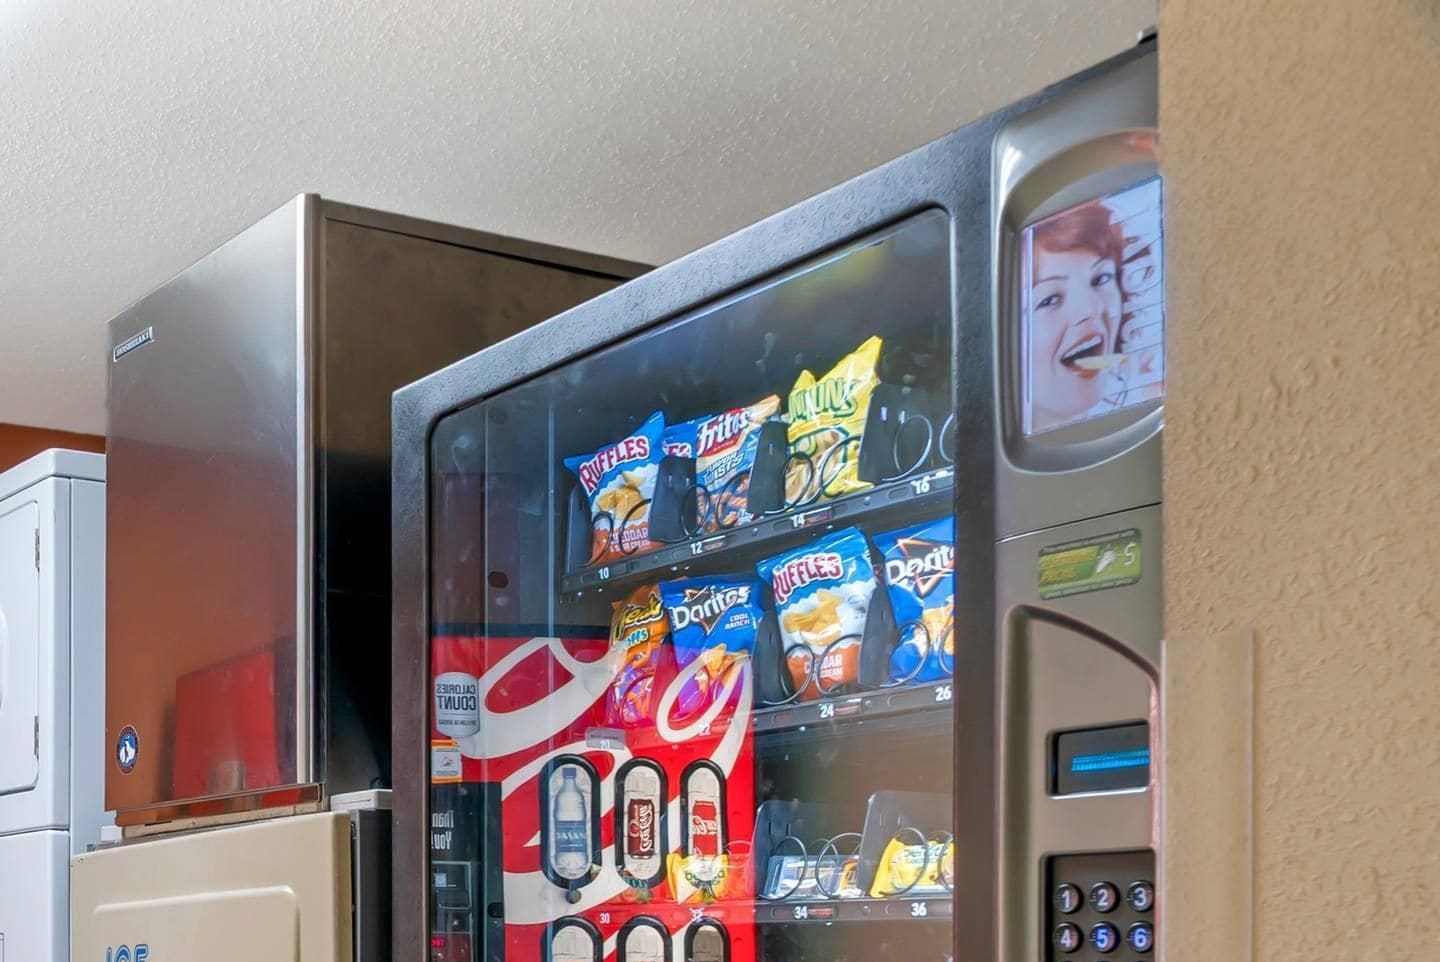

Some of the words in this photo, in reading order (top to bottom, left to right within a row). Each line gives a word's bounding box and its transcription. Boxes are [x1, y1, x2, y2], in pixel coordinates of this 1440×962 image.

[697, 410, 751, 456] Fritos
[579, 435, 650, 497] RUFFLES
[913, 477, 930, 494] 16
[792, 515, 805, 527] 14
[691, 542, 703, 554] 12
[598, 566, 609, 580] 10
[671, 586, 751, 630] Doritos
[729, 612, 750, 622] COOL
[936, 686, 951, 701] 26
[820, 704, 834, 717] 24
[1061, 890, 1070, 908] 1
[1097, 888, 1109, 907] 2
[1133, 887, 1146, 906] 3
[794, 906, 808, 920] 34
[911, 903, 927, 916] 36
[1060, 929, 1072, 948] 4
[1096, 928, 1109, 949] 5
[1133, 928, 1147, 948] 6
